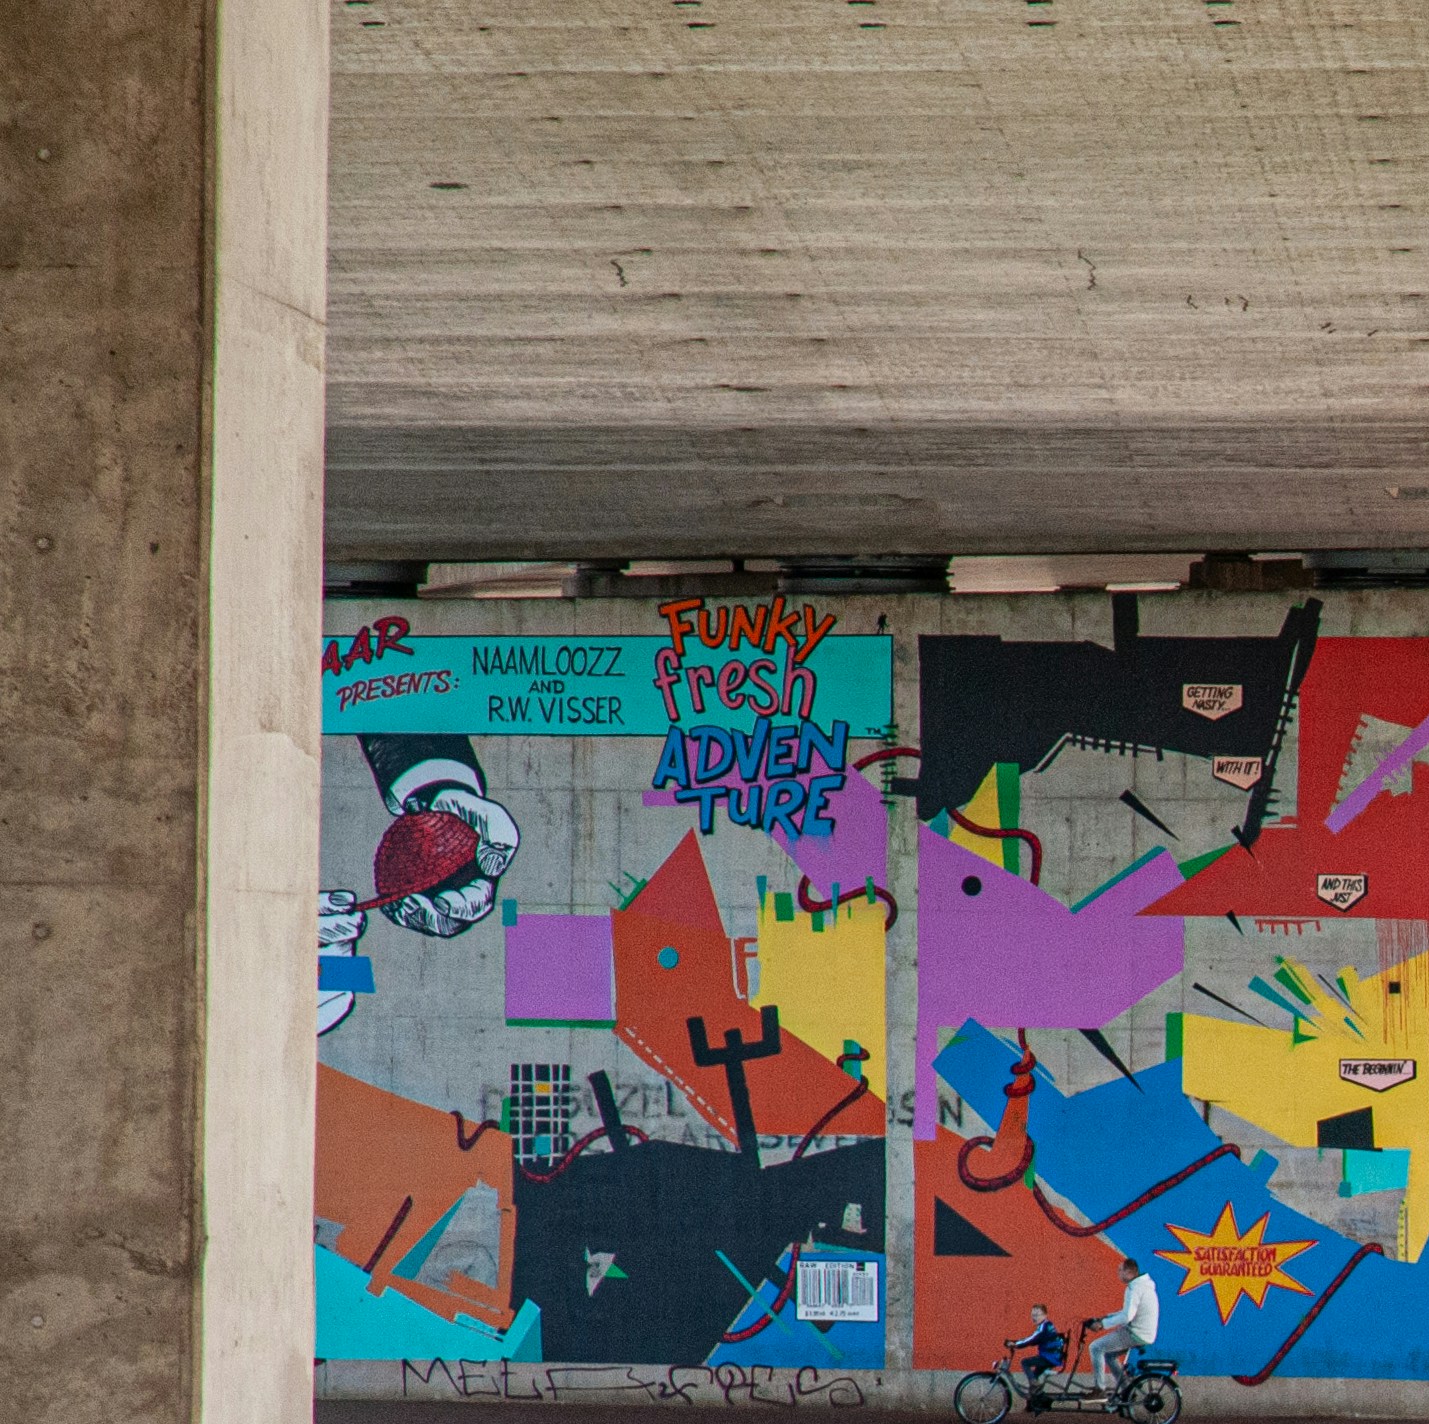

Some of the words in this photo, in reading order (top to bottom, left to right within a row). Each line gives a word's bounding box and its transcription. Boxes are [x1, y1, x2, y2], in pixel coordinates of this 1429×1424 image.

[471, 645, 625, 676] NAAMLOOZZ
[336, 670, 460, 712] PRESENTS:
[528, 679, 565, 694] AND
[653, 646, 817, 722] fresh
[1186, 686, 1233, 699] GETTING
[488, 695, 532, 723] R.W.
[538, 696, 625, 725] VISSER
[1216, 761, 1243, 775] WITH
[1321, 878, 1341, 890] AND
[1342, 879, 1362, 891] THIS
[1342, 1063, 1361, 1075] THE
[1194, 1246, 1277, 1261] SATISFACTION
[1200, 1261, 1273, 1277] GUARANTEED
